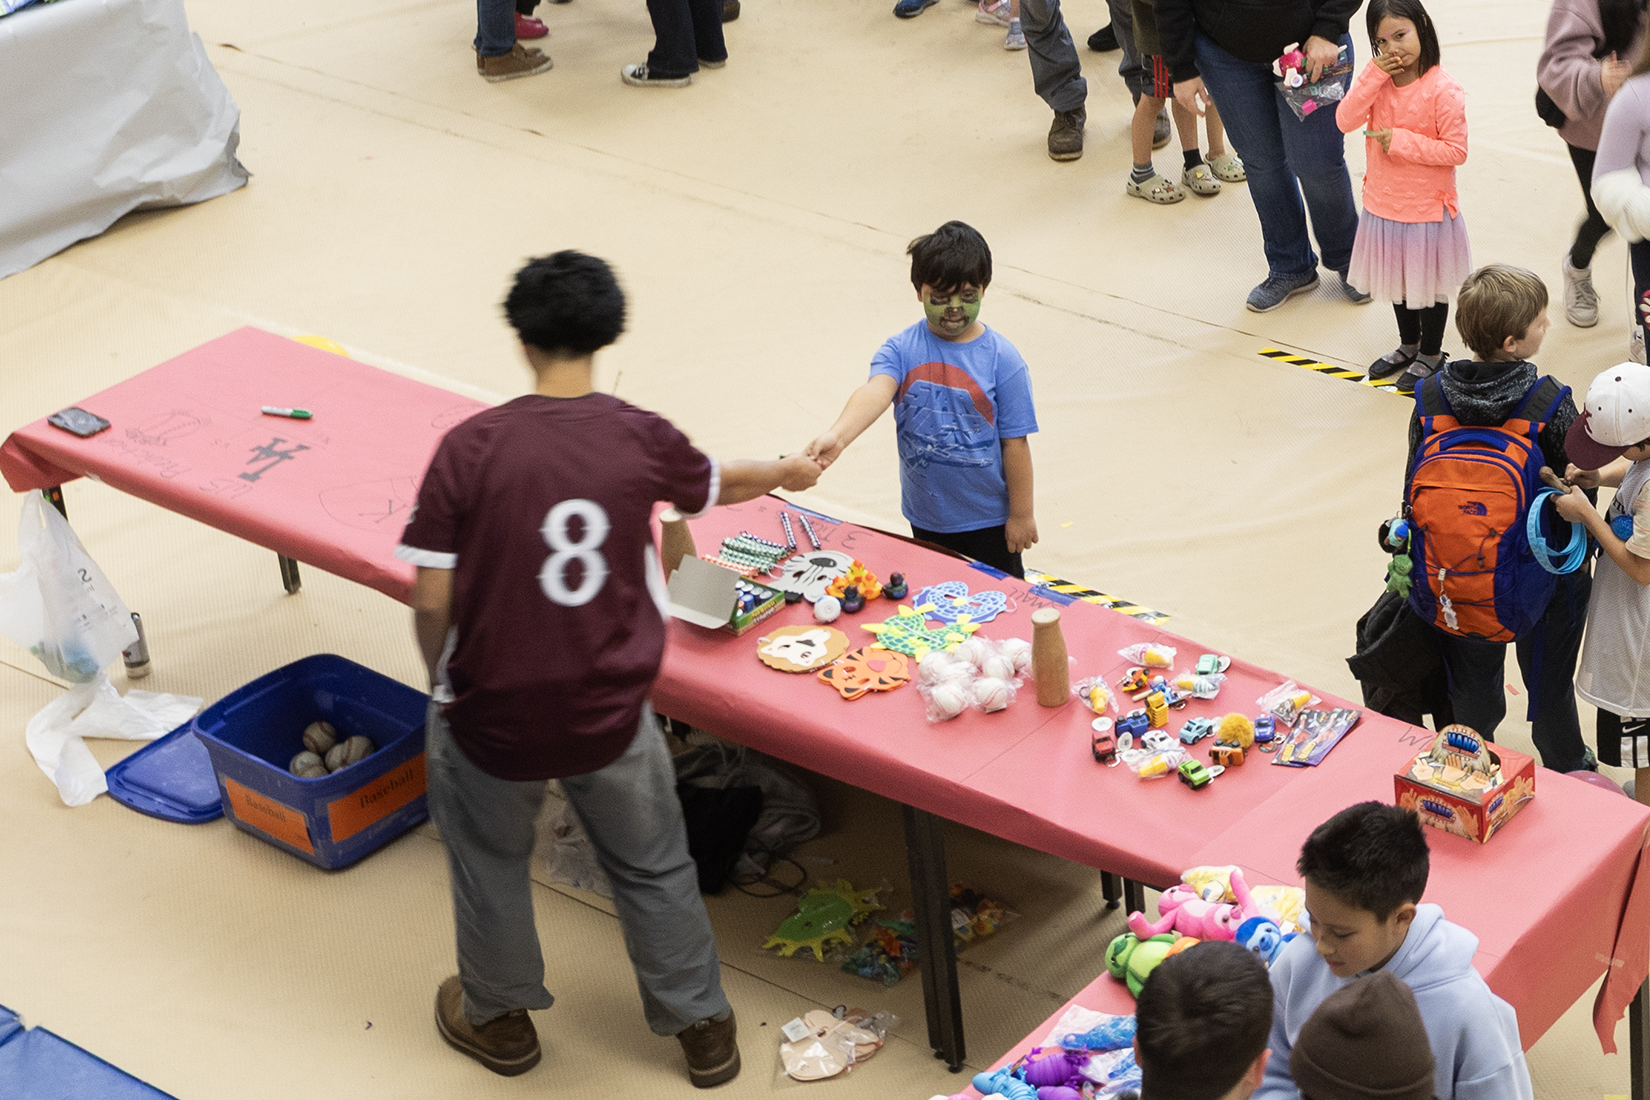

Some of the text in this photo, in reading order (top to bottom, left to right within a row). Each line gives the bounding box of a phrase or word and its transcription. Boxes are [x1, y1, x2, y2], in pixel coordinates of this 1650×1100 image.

[538, 499, 612, 607] 8
[1446, 731, 1480, 753] HAND
[360, 768, 415, 808] Baseball
[245, 793, 287, 822] Baseball
[1422, 799, 1454, 819] HAND
